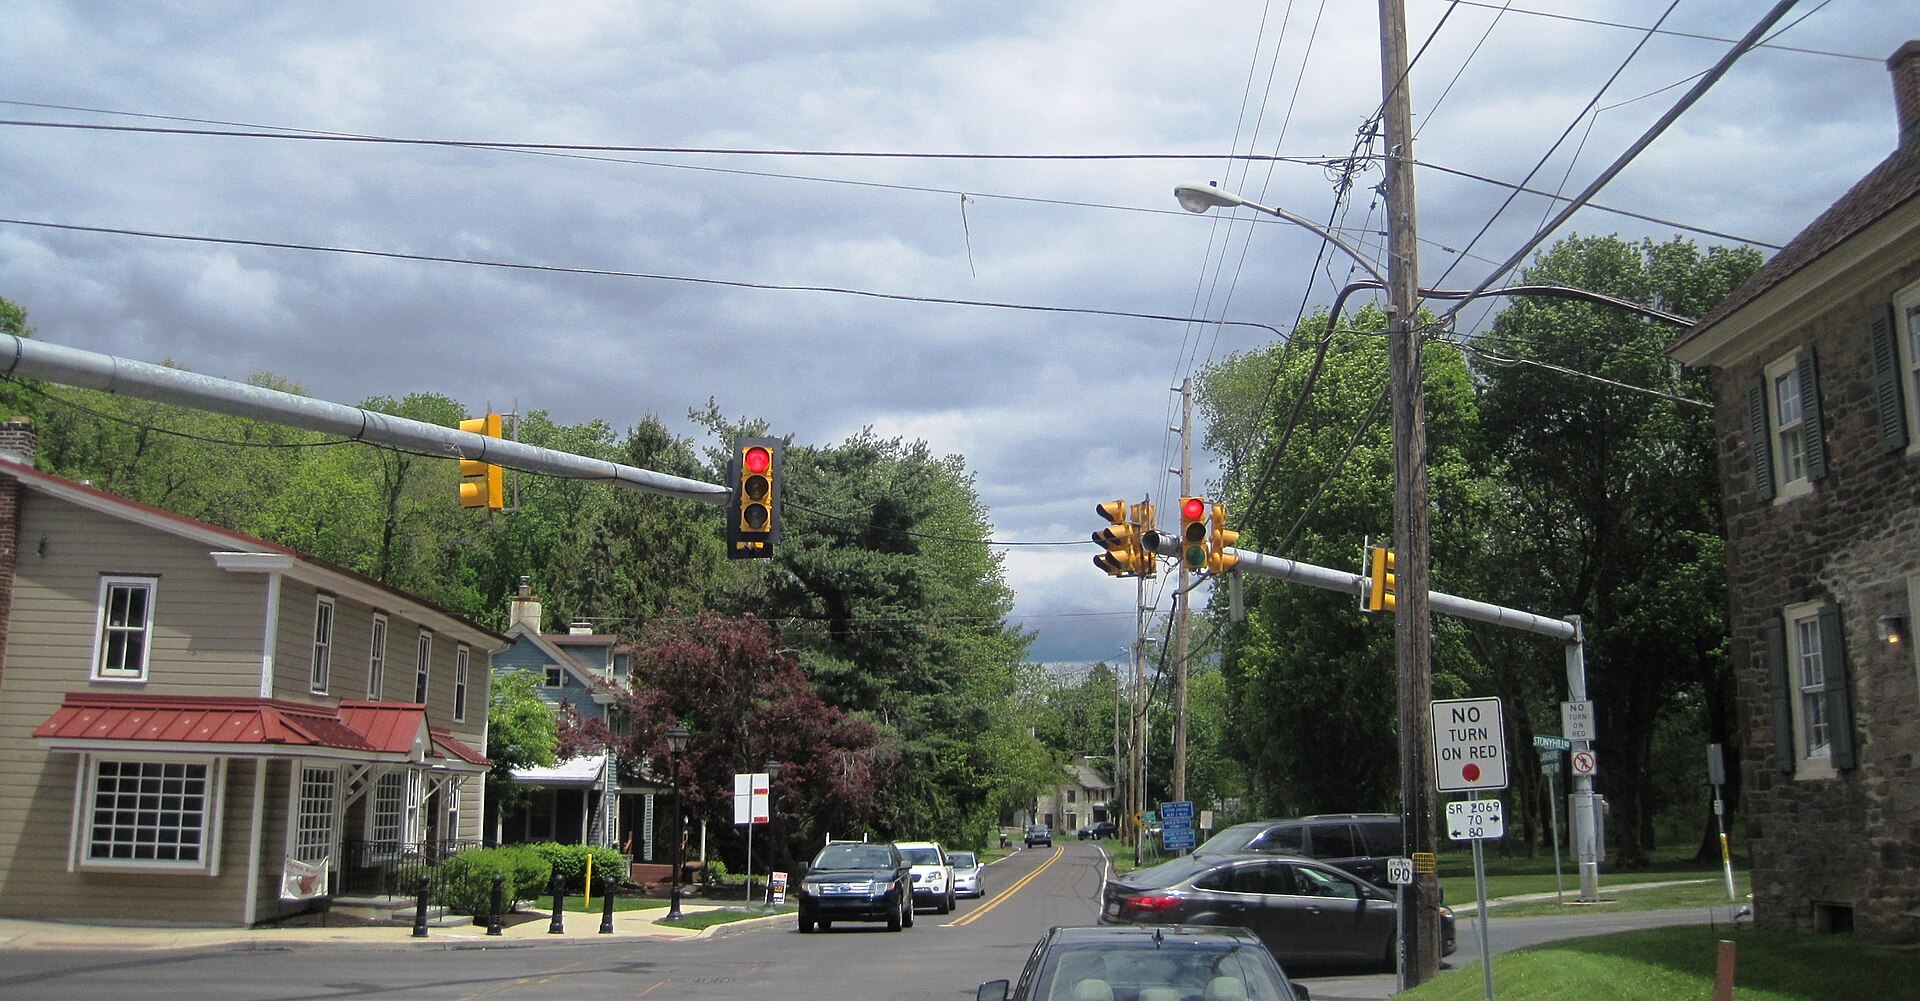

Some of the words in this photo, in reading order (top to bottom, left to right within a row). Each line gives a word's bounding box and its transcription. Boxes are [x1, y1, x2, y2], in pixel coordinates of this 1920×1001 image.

[1570, 704, 1584, 712] NO
[1452, 707, 1480, 723] NO
[1569, 713, 1587, 721] TURN
[1449, 727, 1488, 742] TURN
[1572, 730, 1586, 738] RED
[1442, 748, 1462, 761] ON
[1470, 745, 1497, 759] RED
[1448, 803, 1463, 814] SR
[1471, 801, 1500, 813] 2069
[1468, 815, 1483, 825] 70
[1469, 827, 1484, 838] 80
[1390, 868, 1410, 882] 190
